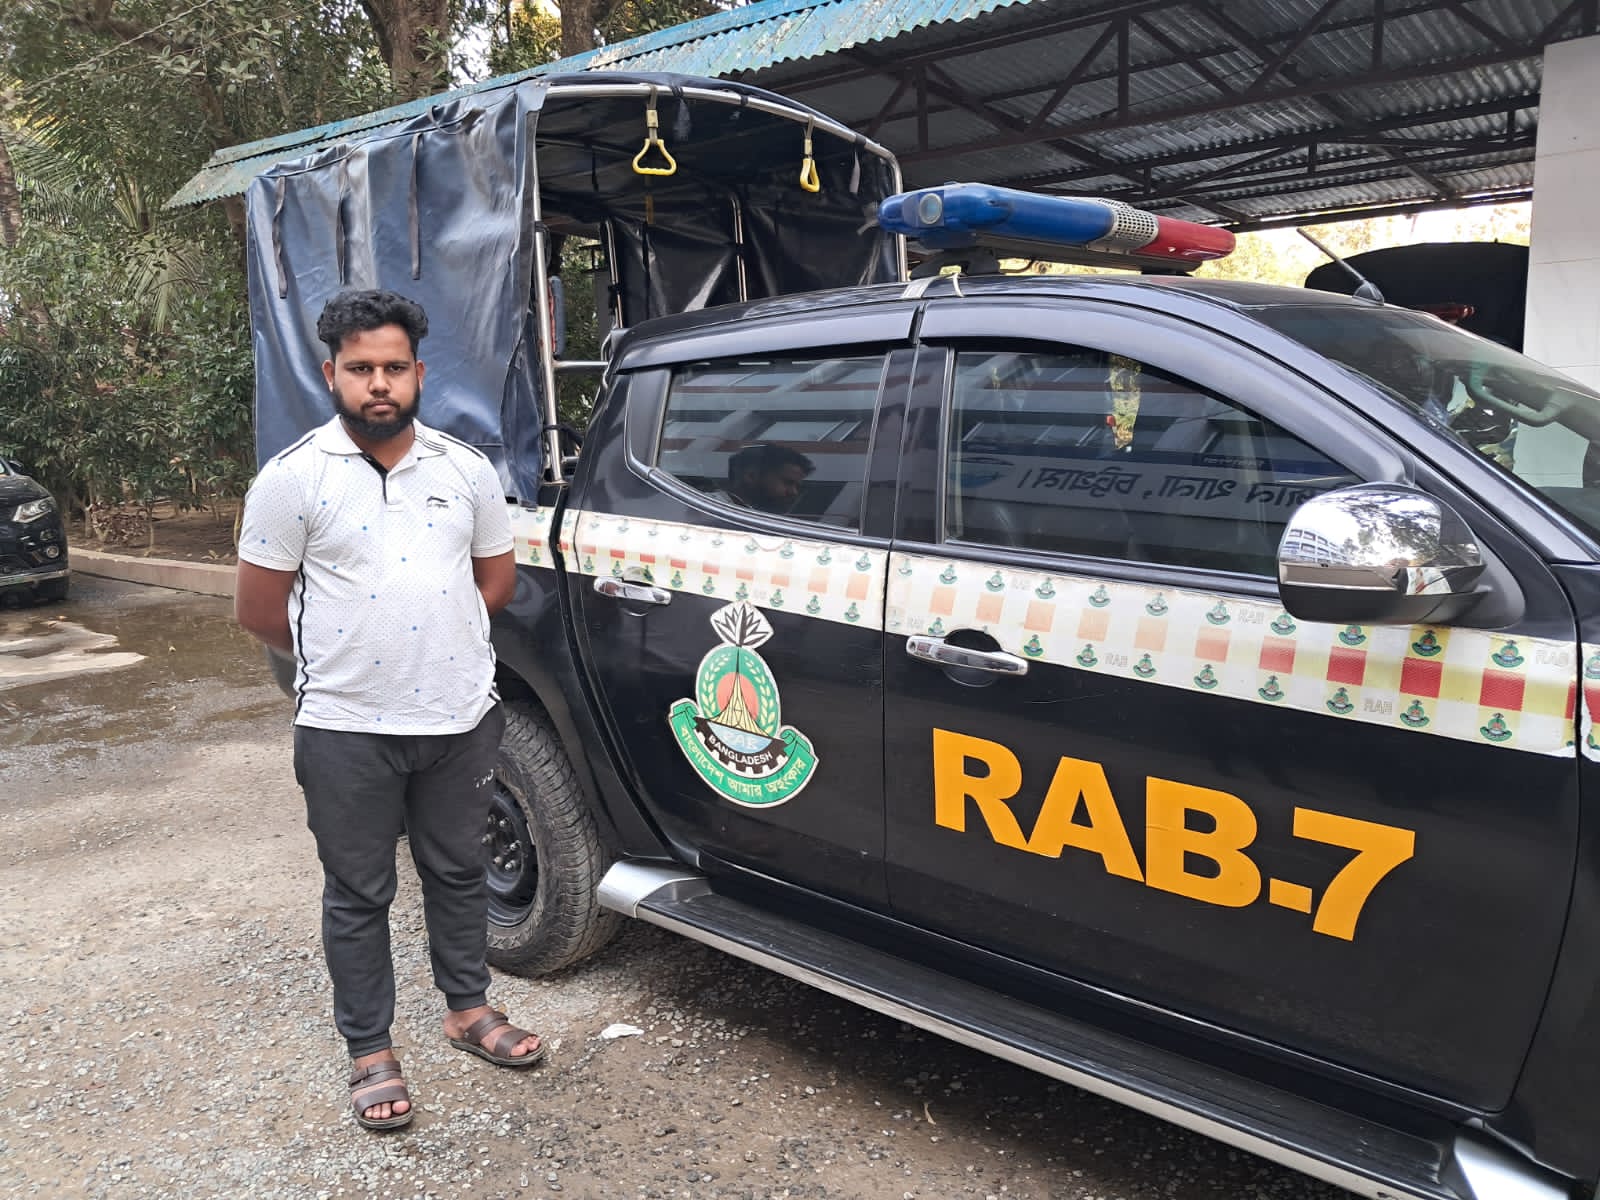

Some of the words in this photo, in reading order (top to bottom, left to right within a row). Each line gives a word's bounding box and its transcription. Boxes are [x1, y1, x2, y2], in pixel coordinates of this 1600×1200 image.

[1363, 697, 1392, 716] RAB
[681, 727, 724, 783] বাংলাদেশ
[727, 777, 762, 796] আমার
[709, 735, 772, 765] BANGLADESH
[933, 728, 1415, 941] RAB-7
